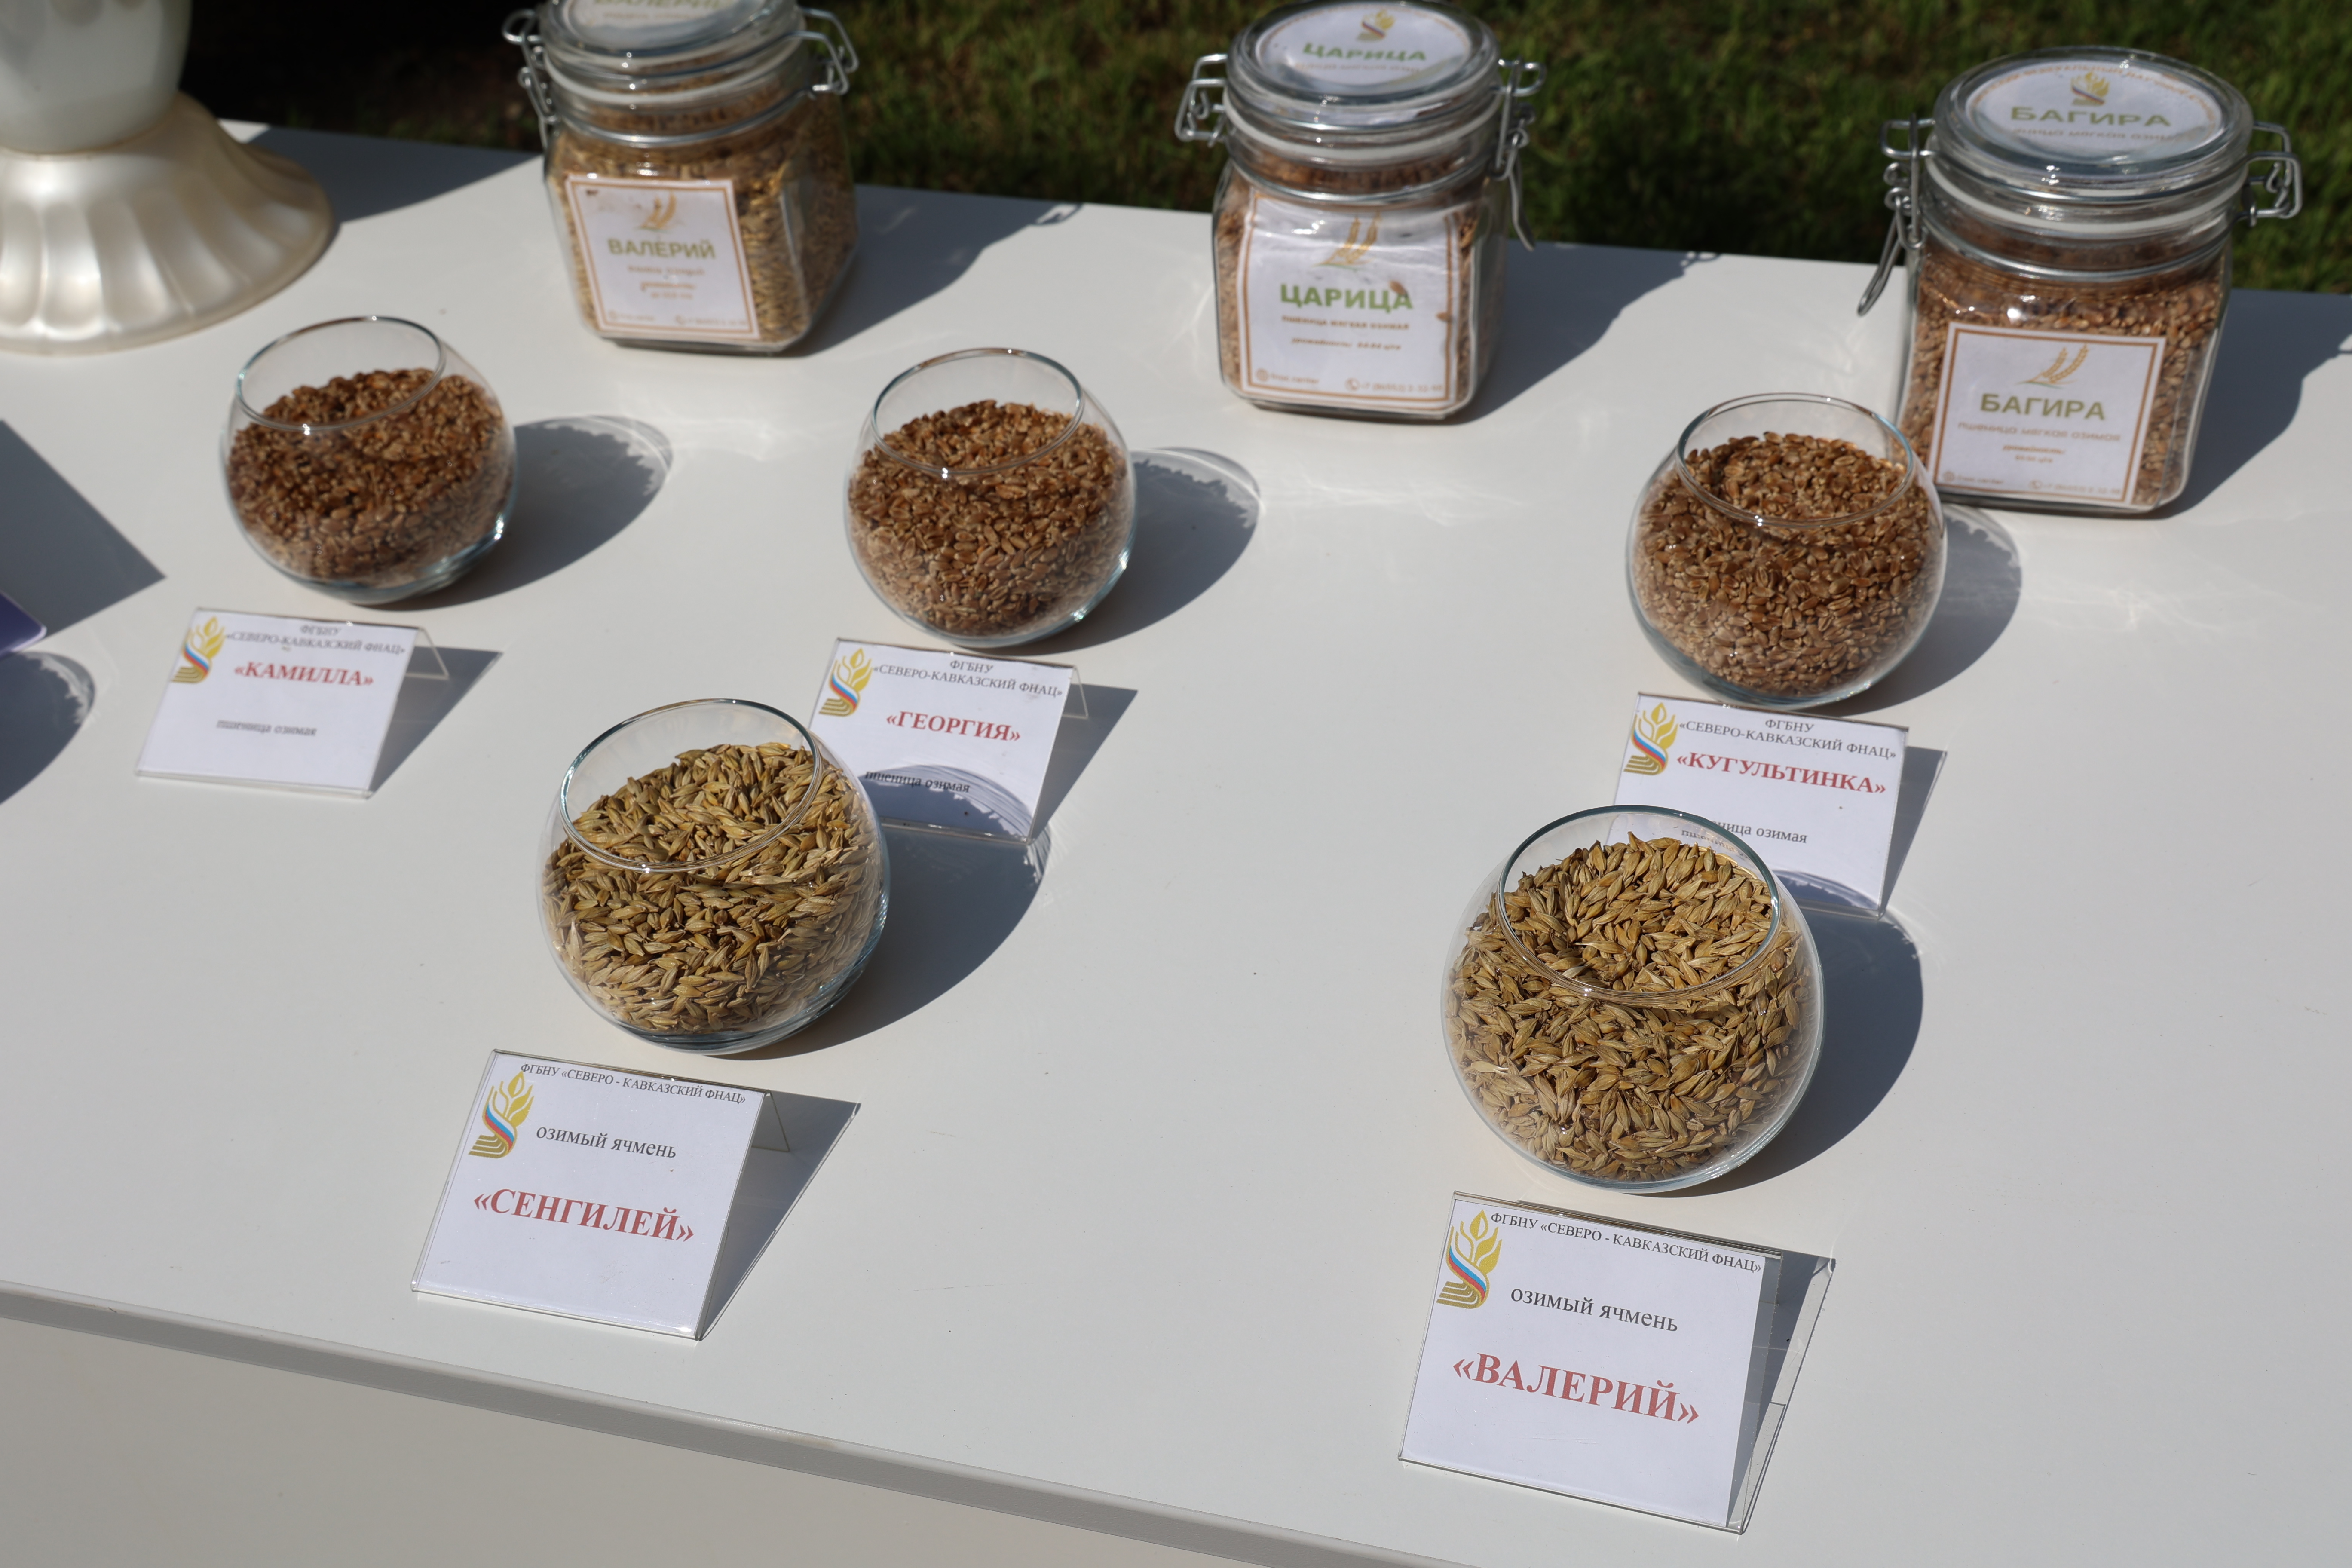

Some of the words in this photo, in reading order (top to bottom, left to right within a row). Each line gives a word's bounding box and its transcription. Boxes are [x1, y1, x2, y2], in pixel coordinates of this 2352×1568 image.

[1303, 43, 1427, 61] ЦАРИЦА
[2011, 106, 2171, 126] БАГИРА
[607, 238, 715, 258] ВАЛЕРИЙ
[1280, 284, 1413, 314] ЦАРИЦА
[1980, 393, 2105, 420] БАГИРА
[234, 662, 374, 686] «КАМИЛЛА»
[873, 664, 1017, 690] «СЕВЕРО-КАВКАЗСКИЙ
[1019, 683, 1063, 698] ФНАЦ»
[950, 659, 993, 674] ФГБНУ
[886, 711, 1021, 742] «ГЕОРГИЯ»
[1679, 720, 1843, 751] «СЕВЕРО-КАВКАЗСКИЙ
[1846, 743, 1896, 760] ФНАЦ»
[1764, 718, 1815, 733] ФГБНУ
[864, 771, 922, 787] пшеница
[925, 778, 970, 793] озимая
[1676, 752, 1886, 794] «КУГУЛЬТИНКА»
[1756, 828, 1807, 843] озимая
[521, 1063, 560, 1075] ФГБНУ
[561, 1068, 614, 1085] «СЕВЕРО
[622, 1078, 702, 1098] КАВКАЗСКИЙ
[705, 1088, 746, 1104] ФНАЦ»
[536, 1127, 607, 1148] озимый
[611, 1139, 677, 1158] ячмень
[473, 1188, 694, 1242] «СЕНГИЛЕЙ»
[1490, 1212, 1539, 1229] ФГБНУ
[1540, 1222, 1602, 1241] «СЕВЕРО
[1613, 1234, 1709, 1262] КАВКАЗСКИЙ
[1712, 1253, 1761, 1274] ФНАЦ»
[1511, 1289, 1592, 1315] озимый
[1599, 1305, 1678, 1332] ячмень
[1452, 1353, 1699, 1424] «ВАЛЕРИЙ»
